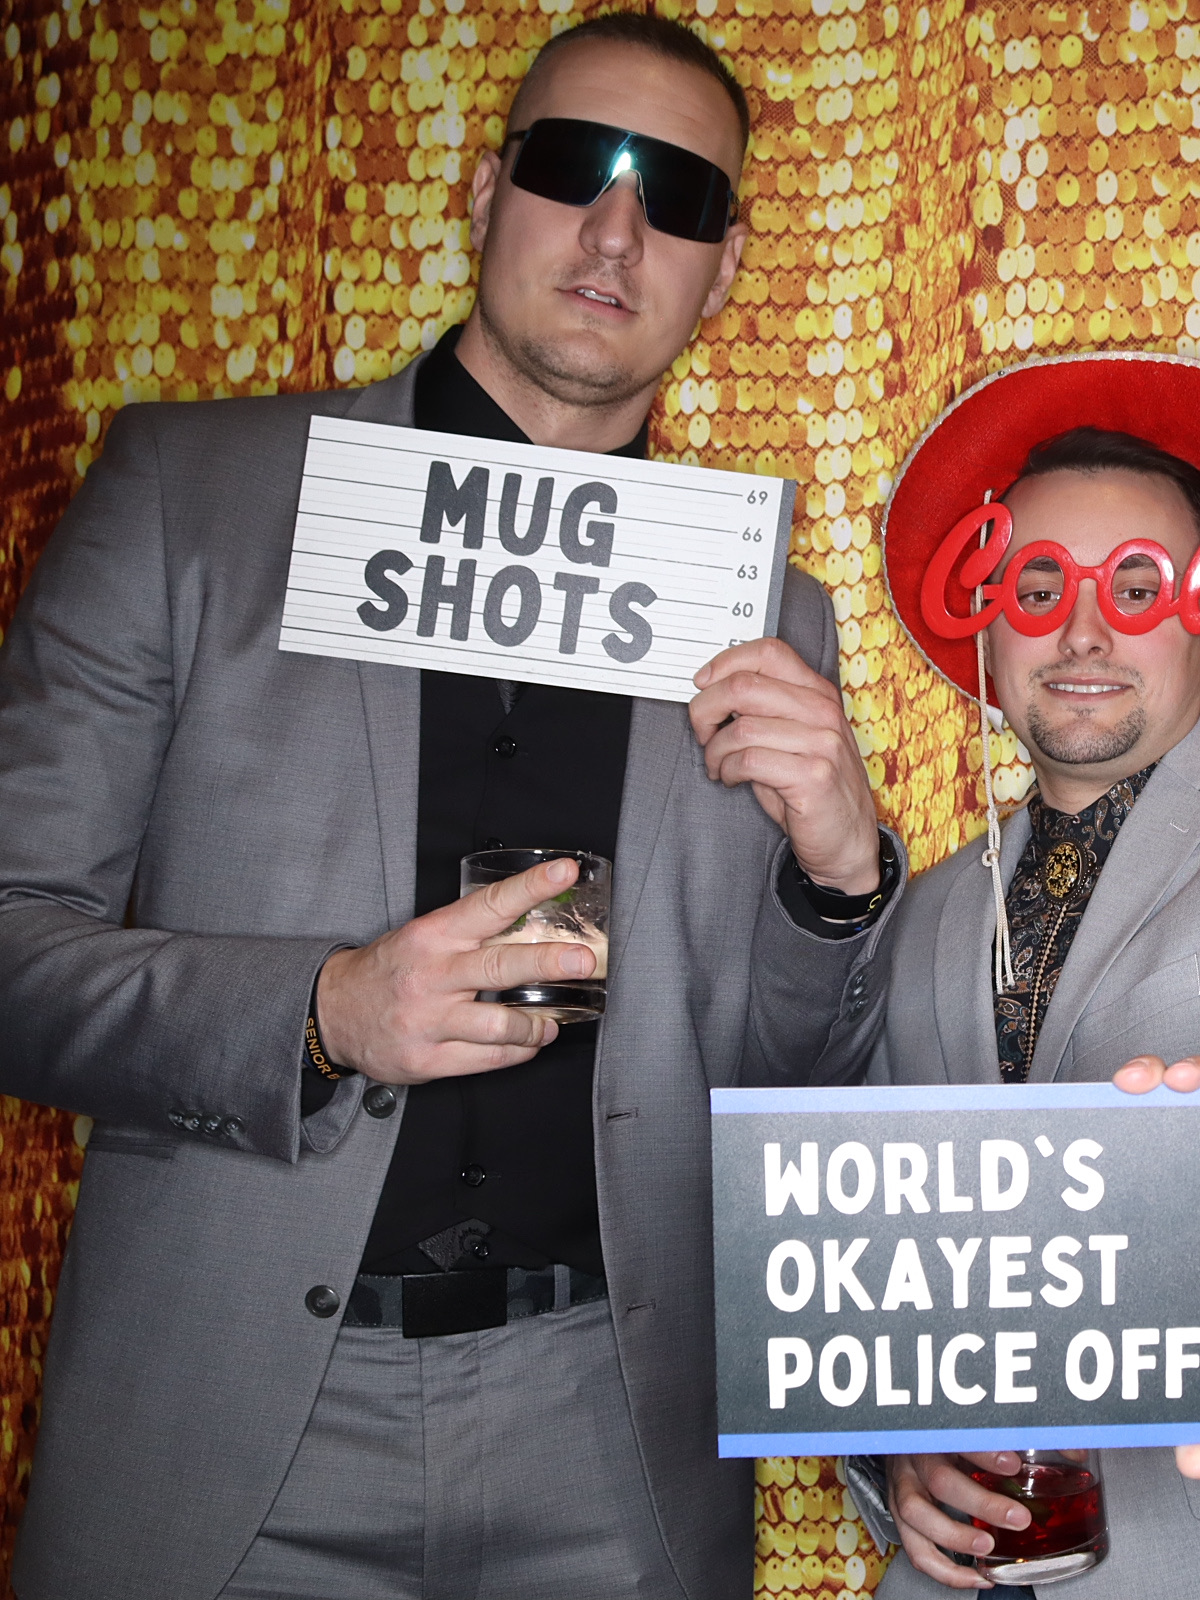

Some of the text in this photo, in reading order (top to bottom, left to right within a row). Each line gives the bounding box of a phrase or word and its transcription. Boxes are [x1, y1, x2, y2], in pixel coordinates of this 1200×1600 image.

[419, 460, 618, 567] MUG
[747, 489, 769, 505] 69
[741, 526, 763, 543] 66
[736, 563, 758, 581] 63
[356, 549, 658, 664] SHOTS
[731, 601, 754, 618] 60
[305, 1017, 332, 1074] SENIOR
[766, 1234, 1129, 1314] OKAYEST
[767, 1331, 1038, 1409] POLICE
